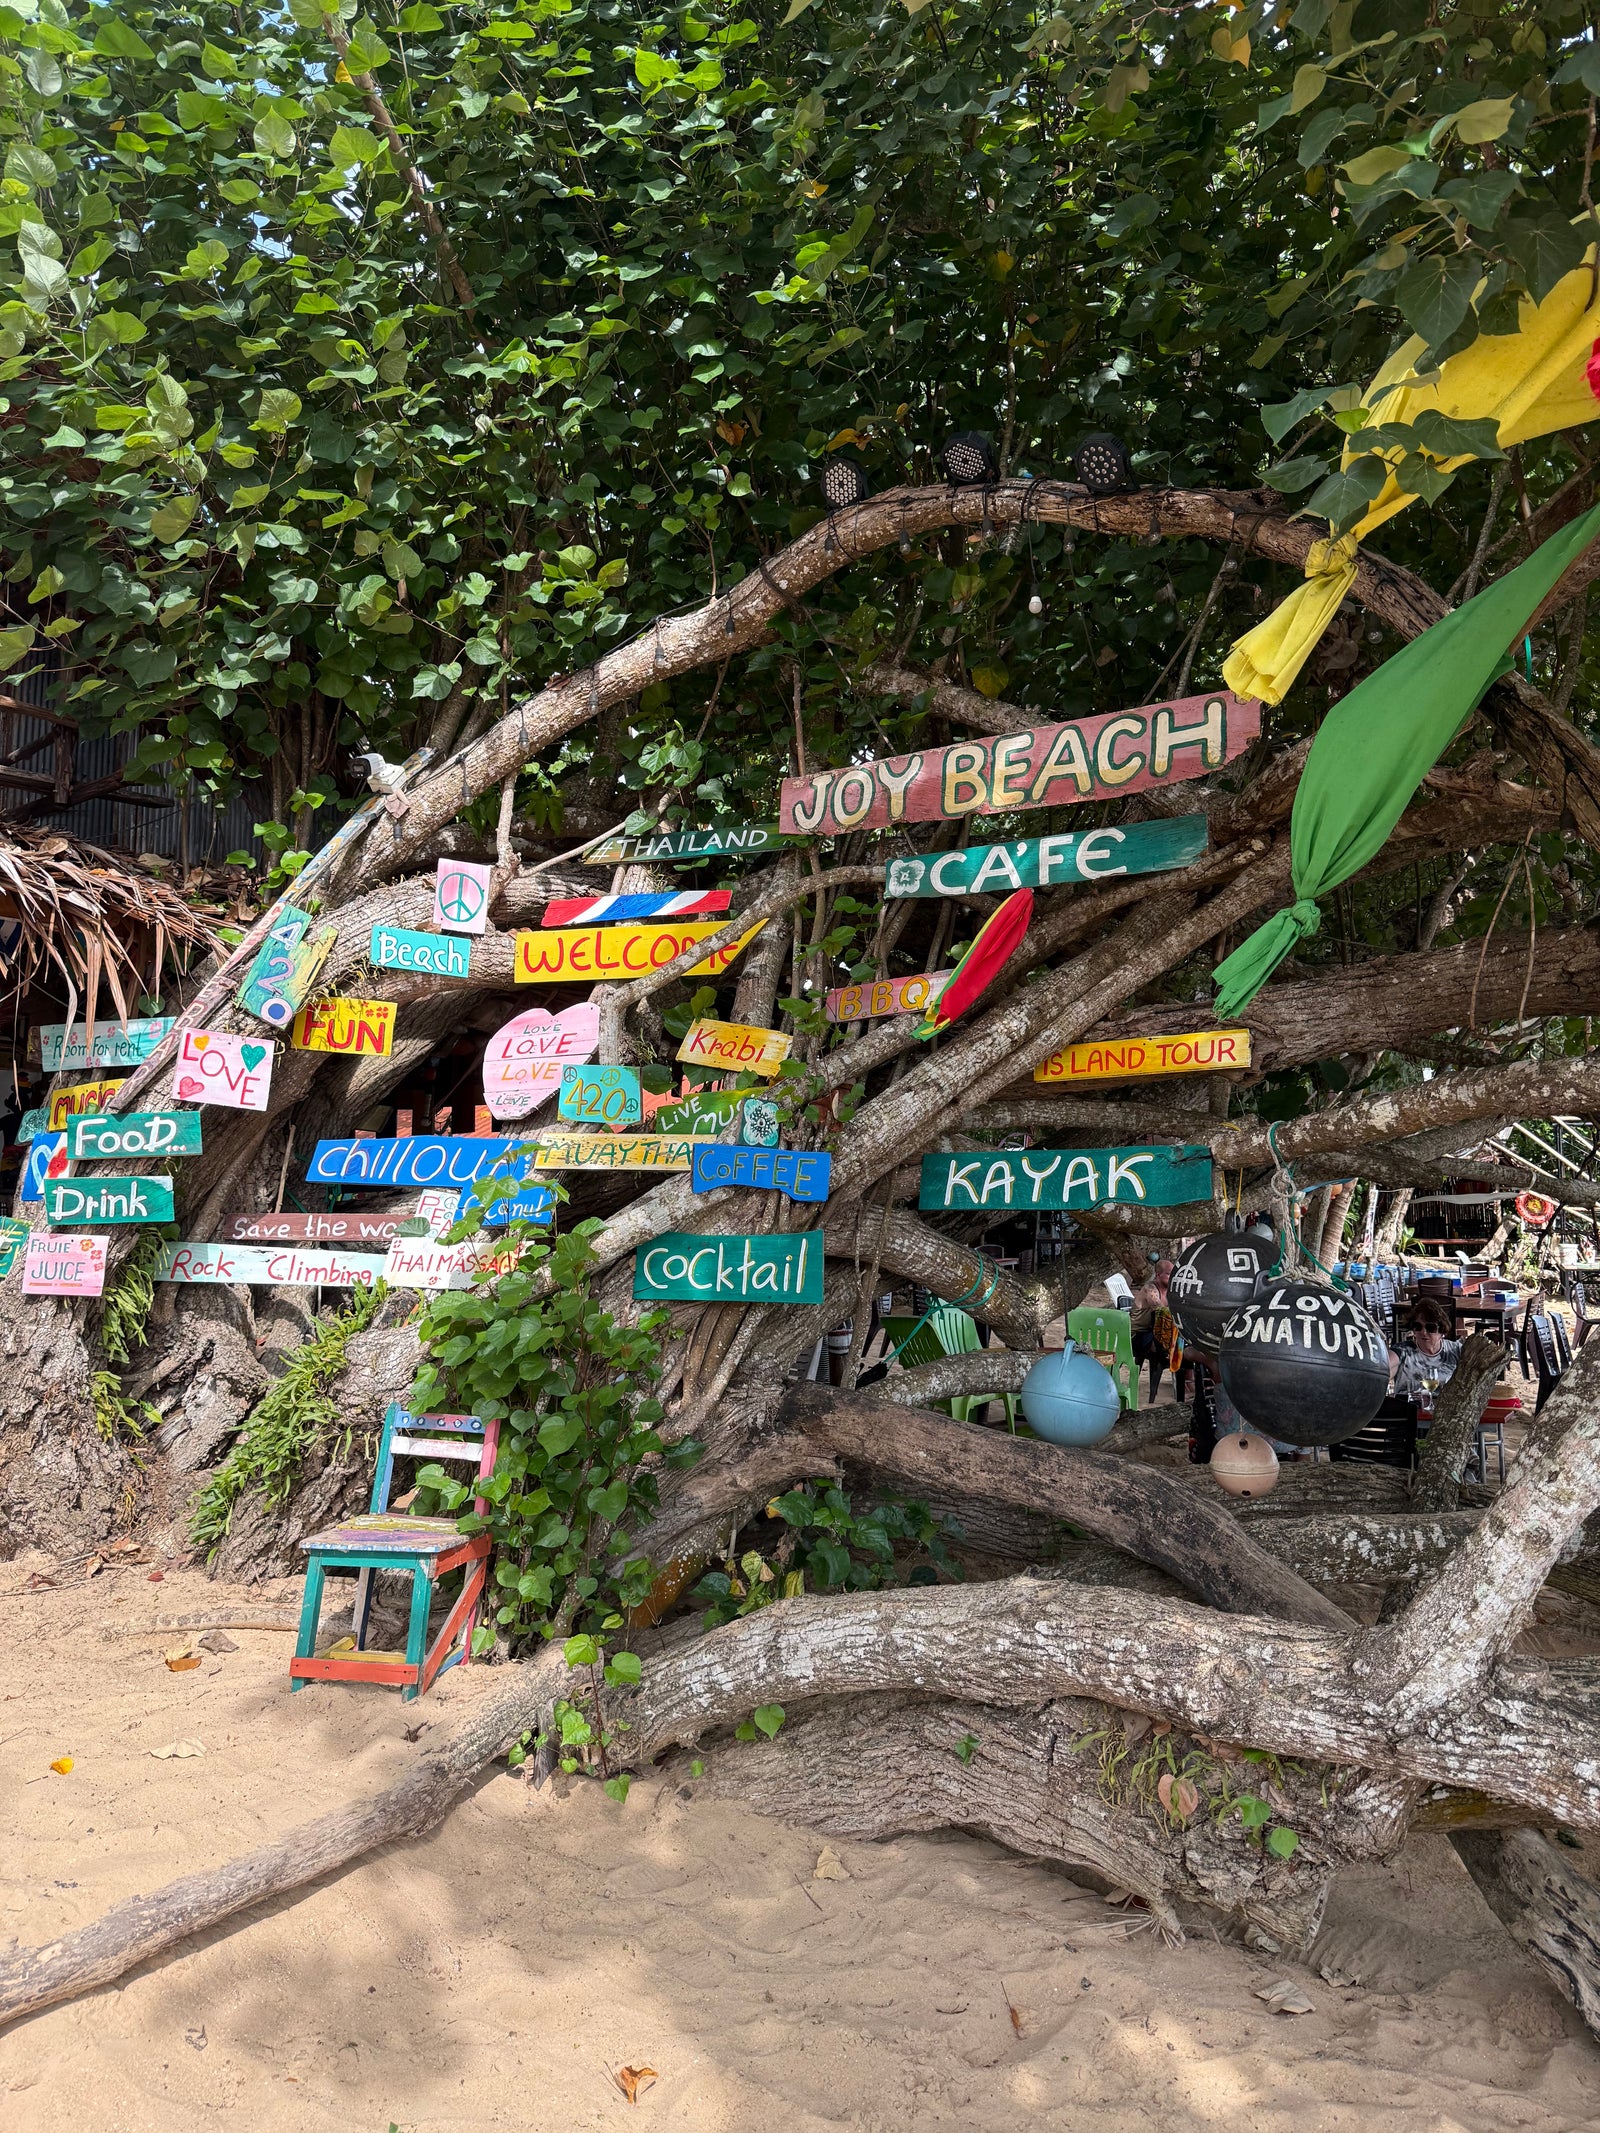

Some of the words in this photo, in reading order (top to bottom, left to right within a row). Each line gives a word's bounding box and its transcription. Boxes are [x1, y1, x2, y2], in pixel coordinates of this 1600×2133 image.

[794, 756, 922, 832] JOY
[941, 698, 1227, 817] BEACH
[377, 931, 463, 974] Beach
[302, 1003, 385, 1054] FUN
[501, 1032, 578, 1059] LOVE
[523, 1023, 562, 1036] LOVE
[690, 1028, 767, 1063] Krabi
[182, 1032, 261, 1106] LOVE
[1043, 1046, 1145, 1077] ISLAND
[1156, 1037, 1238, 1067] TOUR
[543, 1140, 638, 1167] MUAY
[943, 1153, 1154, 1206] KAYAK
[49, 1181, 148, 1221] Drink
[232, 1216, 291, 1240] Save
[304, 1214, 348, 1238] the
[31, 1261, 86, 1282] JUICE
[170, 1249, 236, 1281] Rock
[267, 1255, 373, 1286] Climbing
[391, 1250, 434, 1273] THAI
[1268, 1288, 1369, 1331] LOVE
[1250, 1314, 1380, 1364] NATURE
